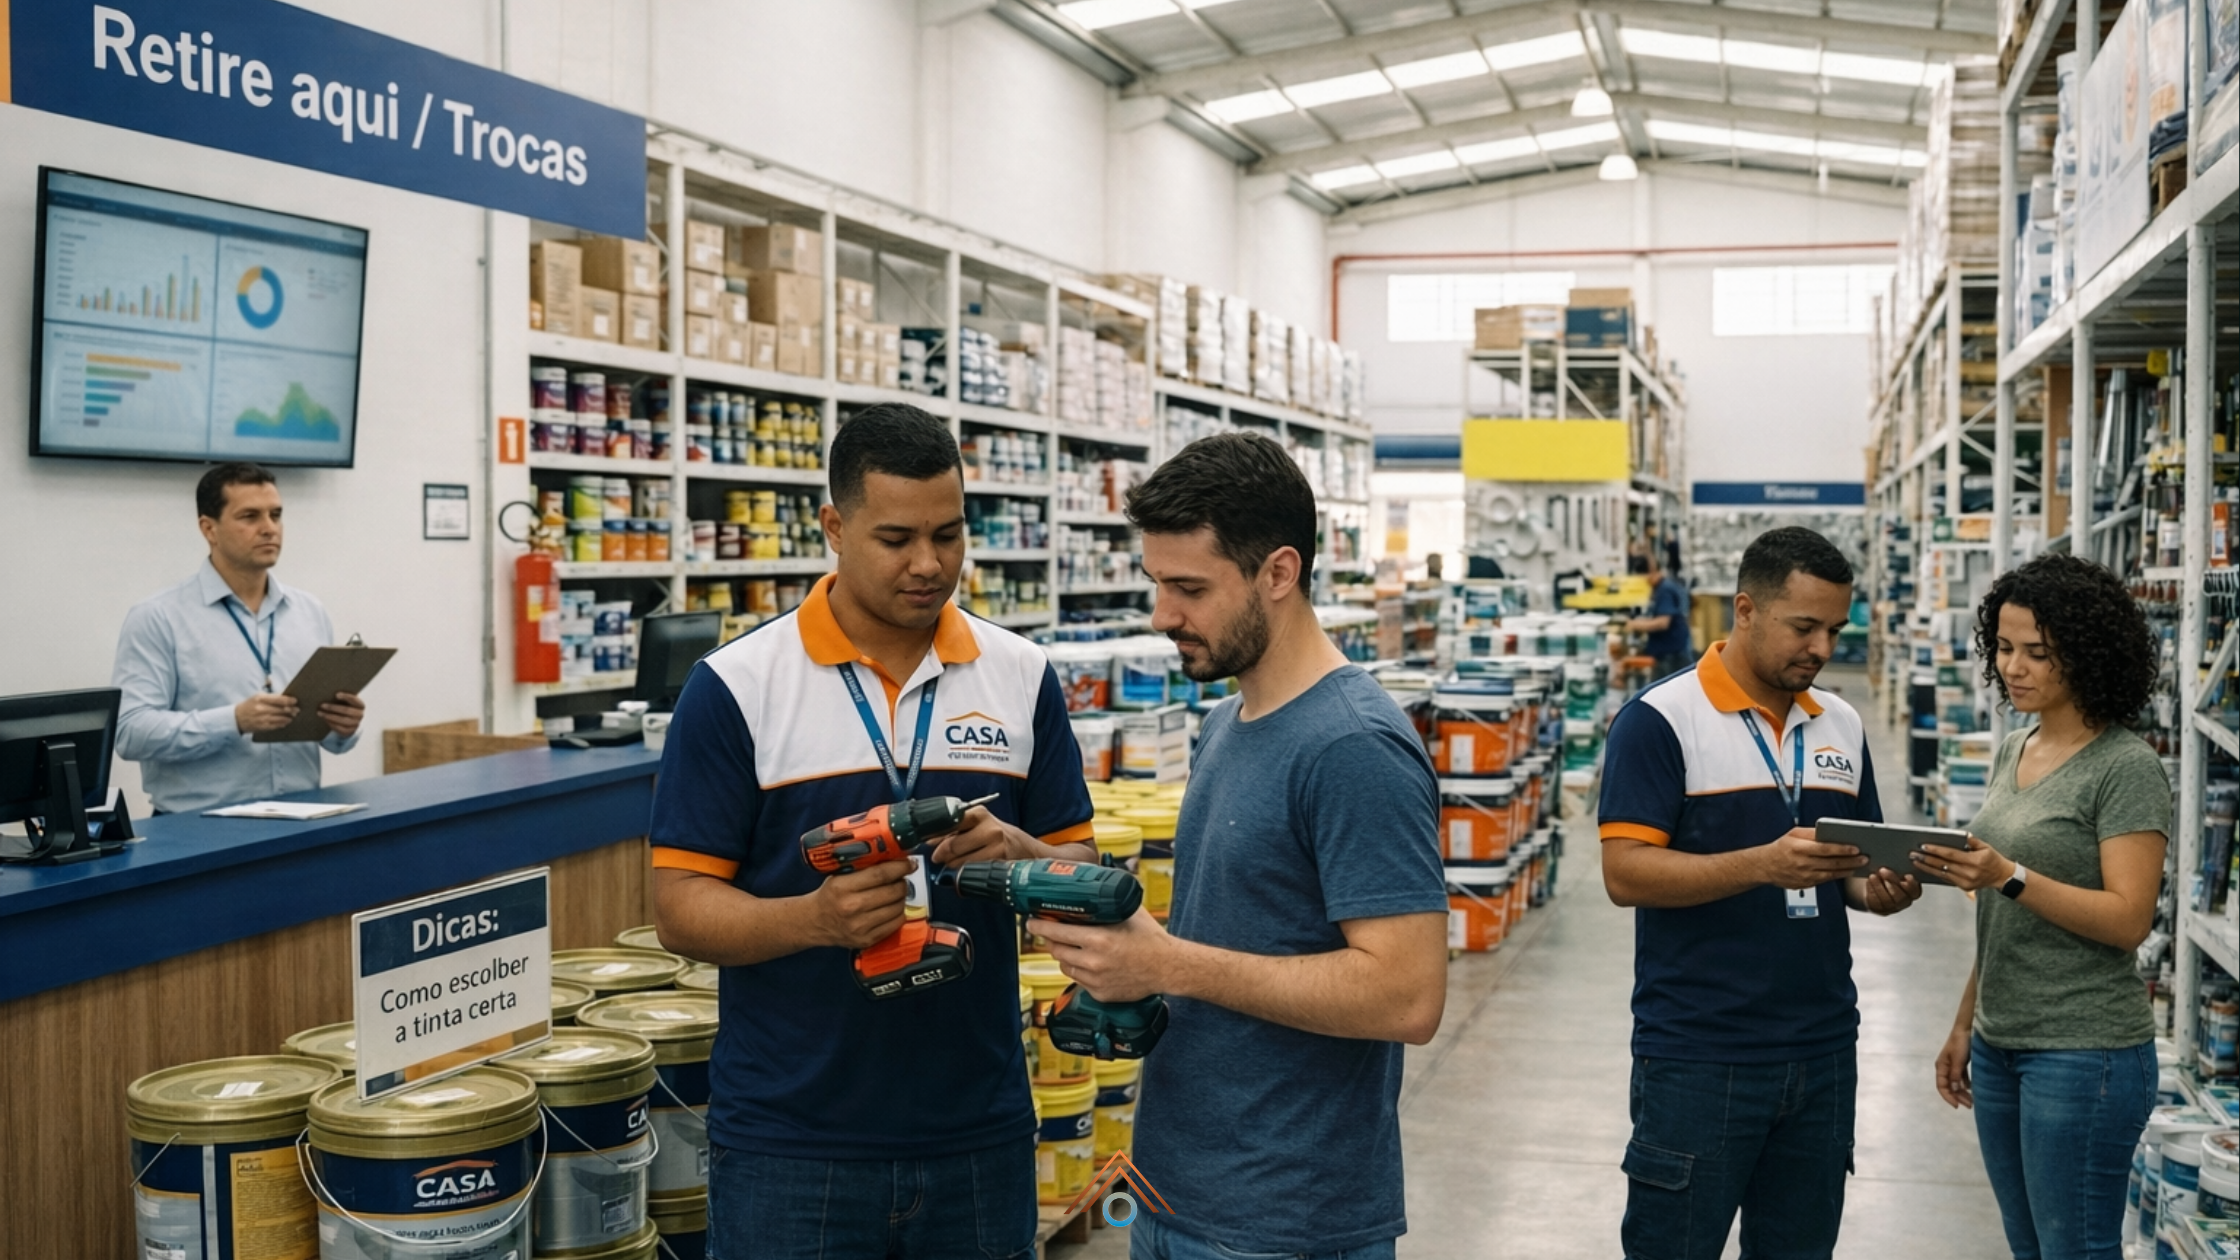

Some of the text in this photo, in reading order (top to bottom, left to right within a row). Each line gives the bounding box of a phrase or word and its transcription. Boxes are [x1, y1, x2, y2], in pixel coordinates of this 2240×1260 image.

[94, 4, 588, 187] Retire aqui / Trocas
[945, 725, 1009, 747] CASA
[1814, 754, 1854, 773] CASA
[412, 909, 499, 953] Dicas:
[380, 982, 443, 1014] Como
[395, 990, 517, 1043] a tinta certa
[416, 1168, 496, 1199] CASA
